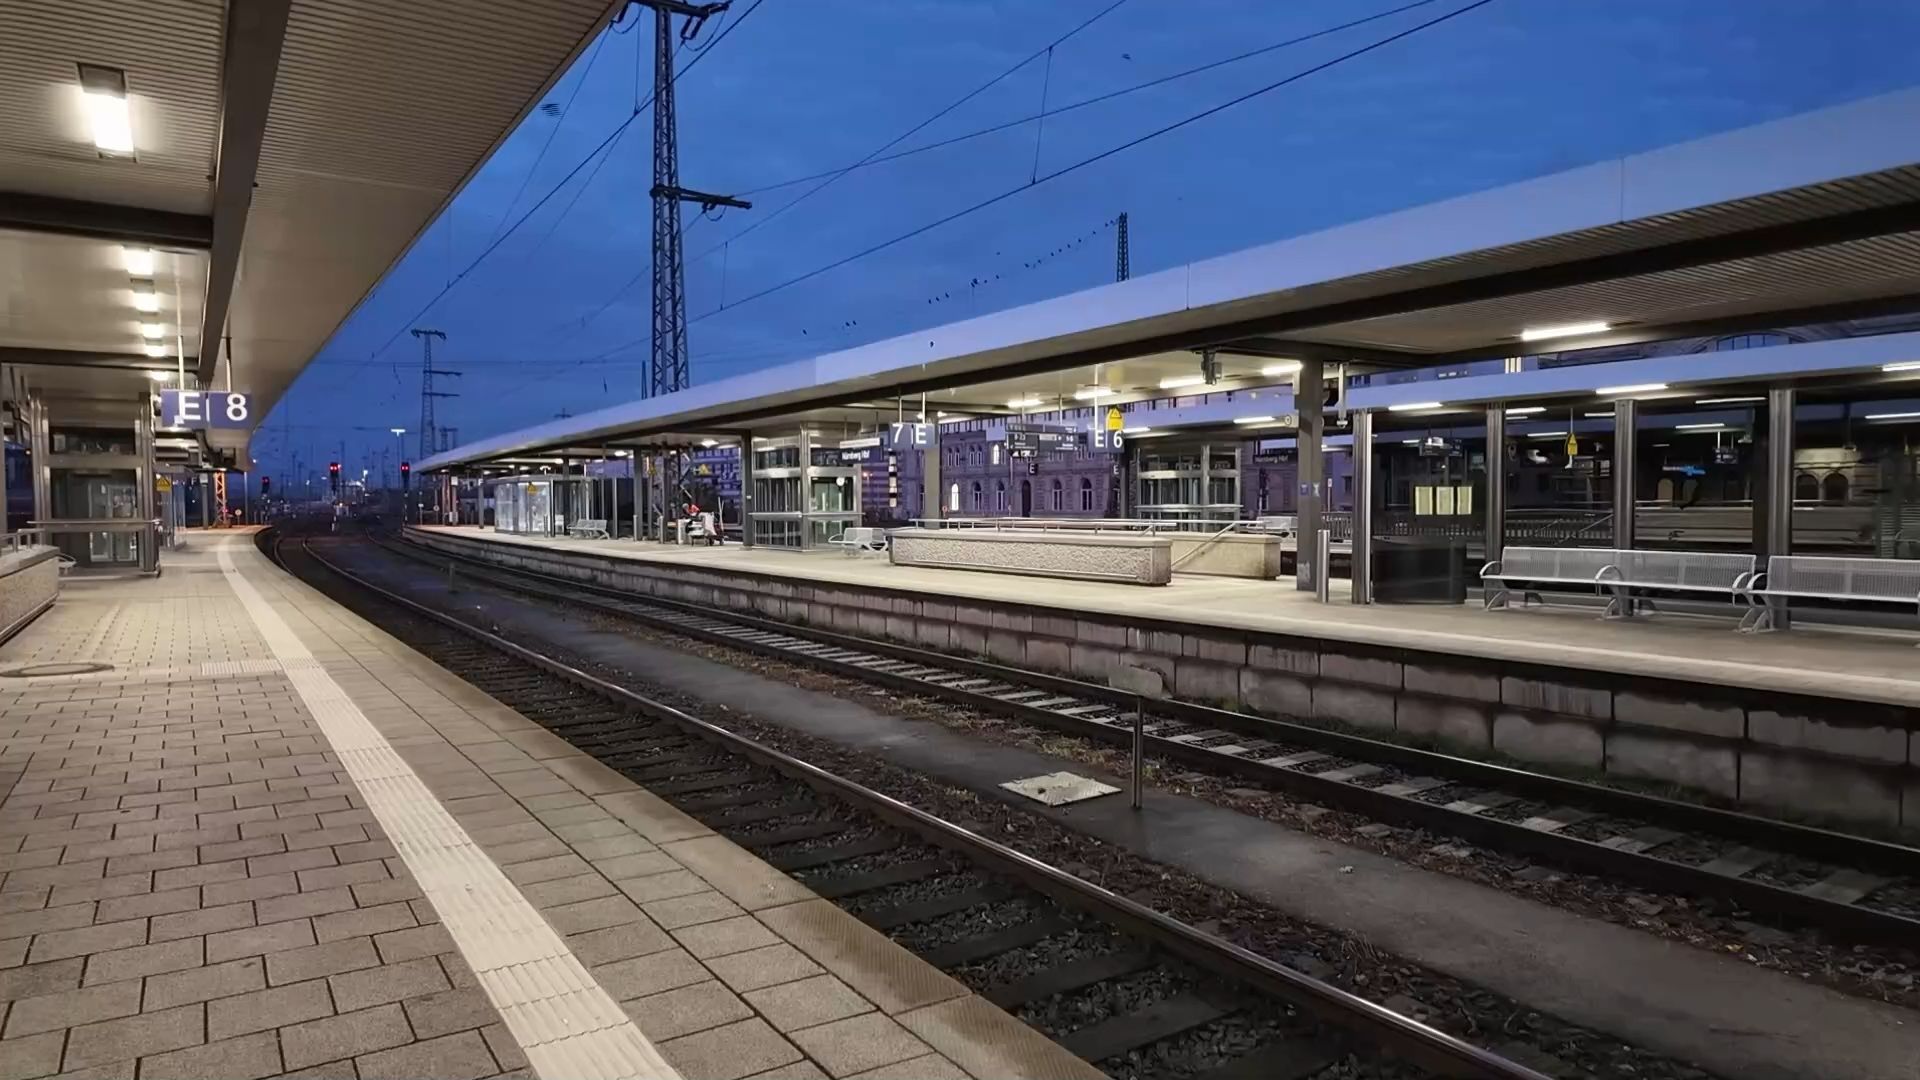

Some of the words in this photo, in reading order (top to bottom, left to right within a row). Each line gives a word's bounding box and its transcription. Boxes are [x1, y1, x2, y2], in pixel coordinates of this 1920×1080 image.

[179, 392, 201, 420] E
[226, 393, 248, 421] 8
[892, 423, 904, 444] 7
[915, 424, 927, 445] E
[1094, 430, 1105, 448] E
[1113, 430, 1123, 448] 6
